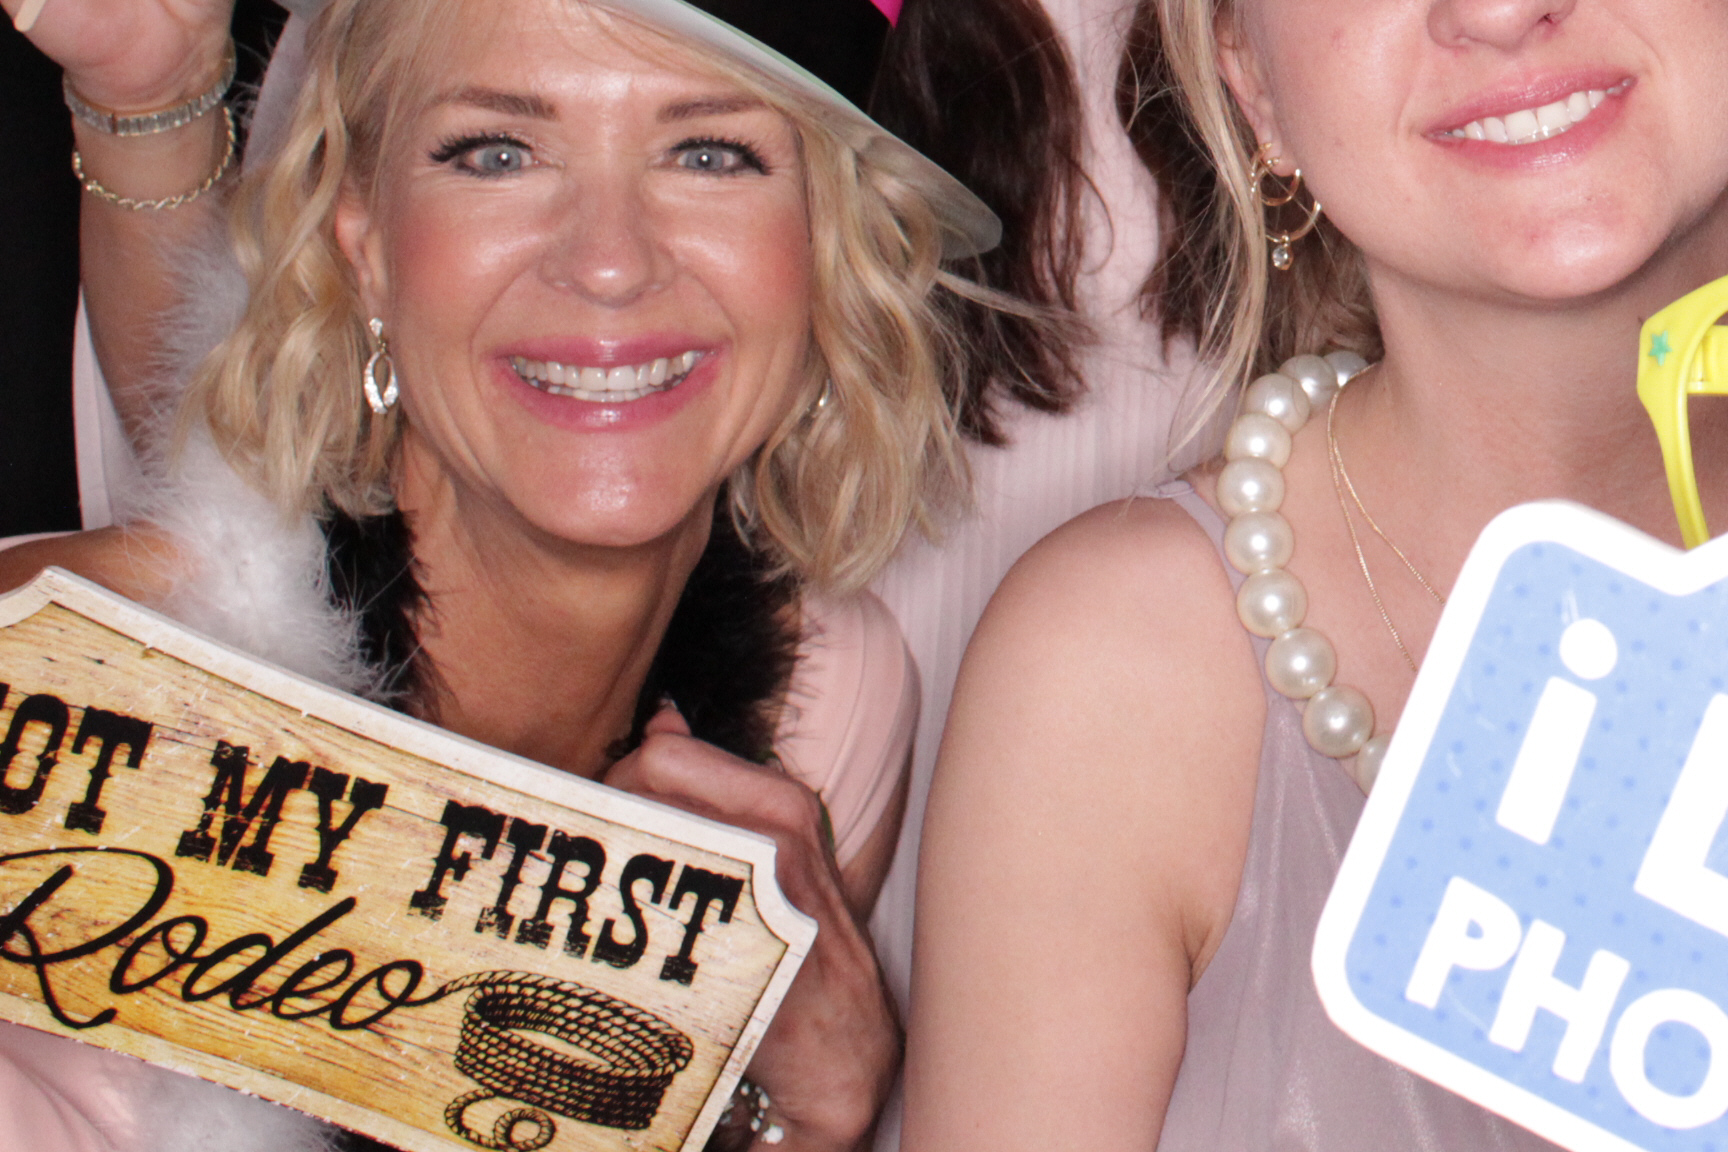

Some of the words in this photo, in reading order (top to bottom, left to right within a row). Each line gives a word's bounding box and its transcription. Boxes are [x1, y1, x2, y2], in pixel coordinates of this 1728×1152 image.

[0, 682, 154, 835] OT
[175, 740, 389, 894] MY
[409, 800, 746, 986] FIRST
[1495, 617, 1619, 846] i
[0, 846, 445, 1030] Rodeo
